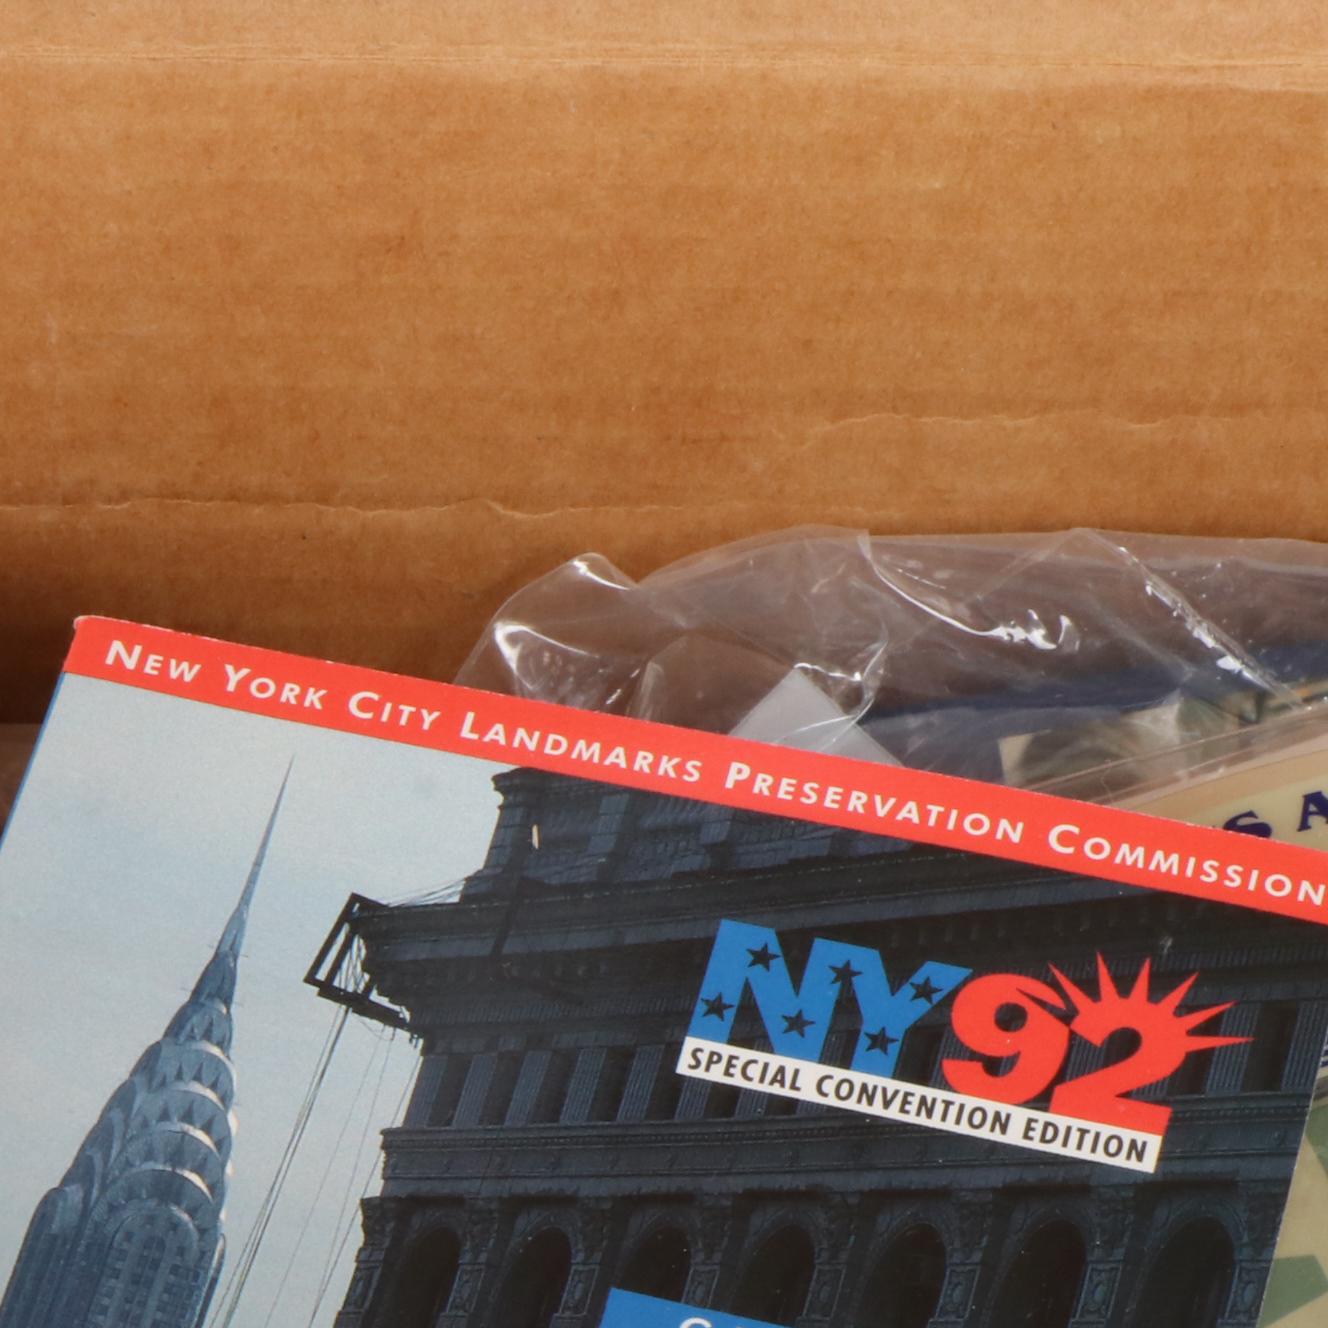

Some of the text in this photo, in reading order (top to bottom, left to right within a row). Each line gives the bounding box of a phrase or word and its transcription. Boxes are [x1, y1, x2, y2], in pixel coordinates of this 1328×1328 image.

[104, 639, 1327, 907] NEW YORK CITY LANDMARKS PRESERVATION COMMISSION
[686, 1046, 1147, 1164] SPECIAL CONVENTION EDITION
